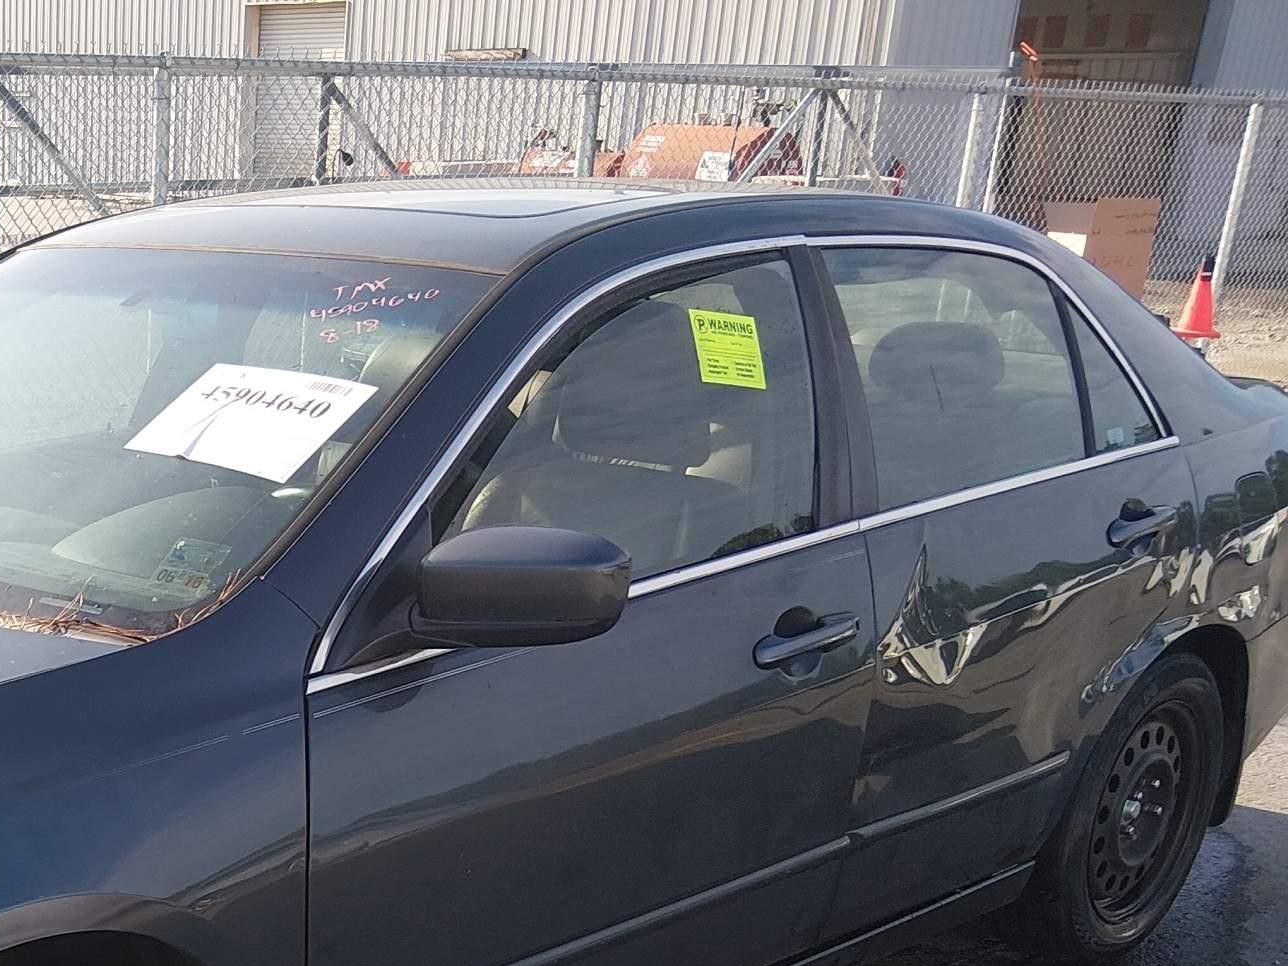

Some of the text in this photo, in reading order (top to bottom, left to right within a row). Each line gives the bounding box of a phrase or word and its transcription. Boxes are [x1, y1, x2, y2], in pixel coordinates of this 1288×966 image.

[309, 288, 440, 322] 45904640
[707, 318, 754, 335] WARNING
[201, 385, 332, 419] 45904640
